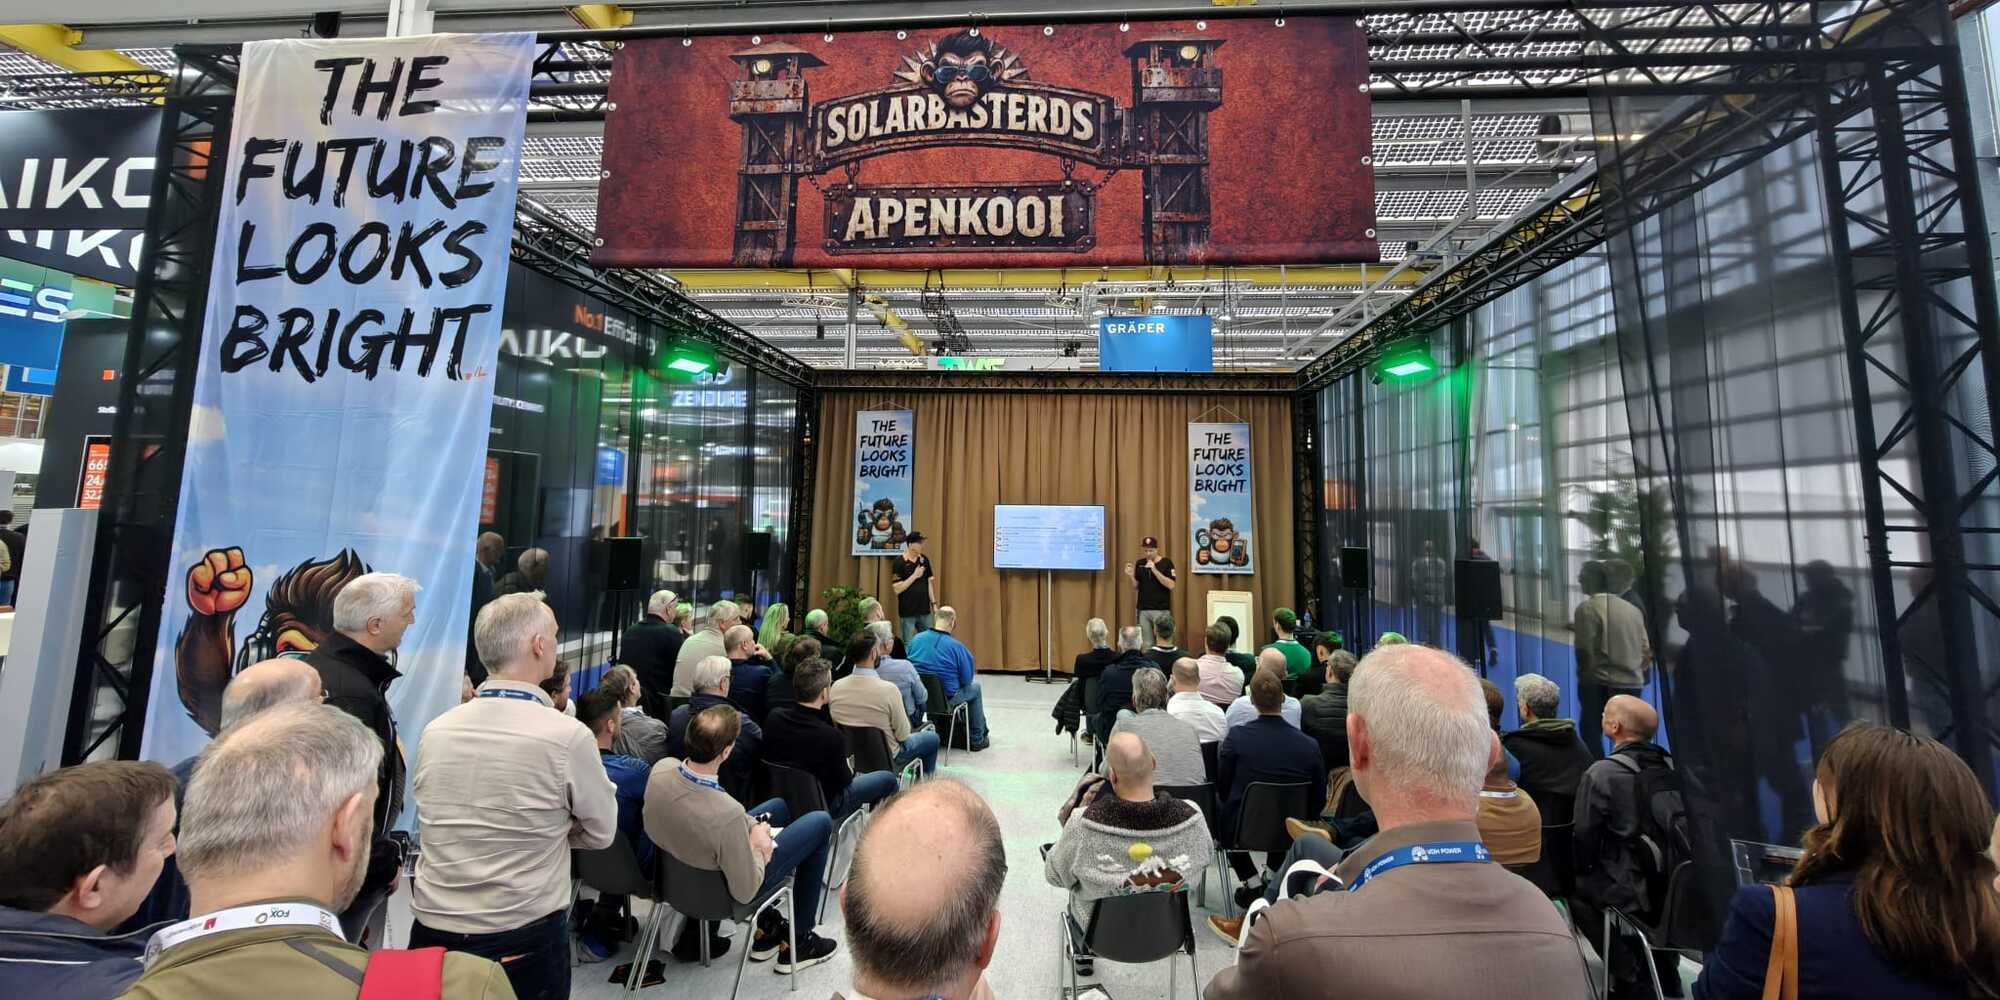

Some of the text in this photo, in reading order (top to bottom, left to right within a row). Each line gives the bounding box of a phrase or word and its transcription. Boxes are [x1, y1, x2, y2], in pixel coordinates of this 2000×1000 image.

[314, 55, 450, 126] THE
[826, 93, 1094, 147] SOLARBASTERDS
[235, 135, 507, 208] FUTURE
[844, 195, 1065, 241] APENKOOI
[235, 218, 489, 288] LOOKS
[1107, 321, 1165, 334] GRÄPER
[220, 303, 494, 382] BRIGHT
[872, 420, 896, 433] THE
[860, 434, 908, 448] FUTURE
[1205, 432, 1232, 446] THE
[861, 450, 906, 462] LOOKS
[1194, 448, 1245, 461] FUTURE
[860, 464, 908, 478] BRIGHT
[1195, 463, 1244, 476] LOOKS
[1194, 479, 1247, 493] BRIGHT
